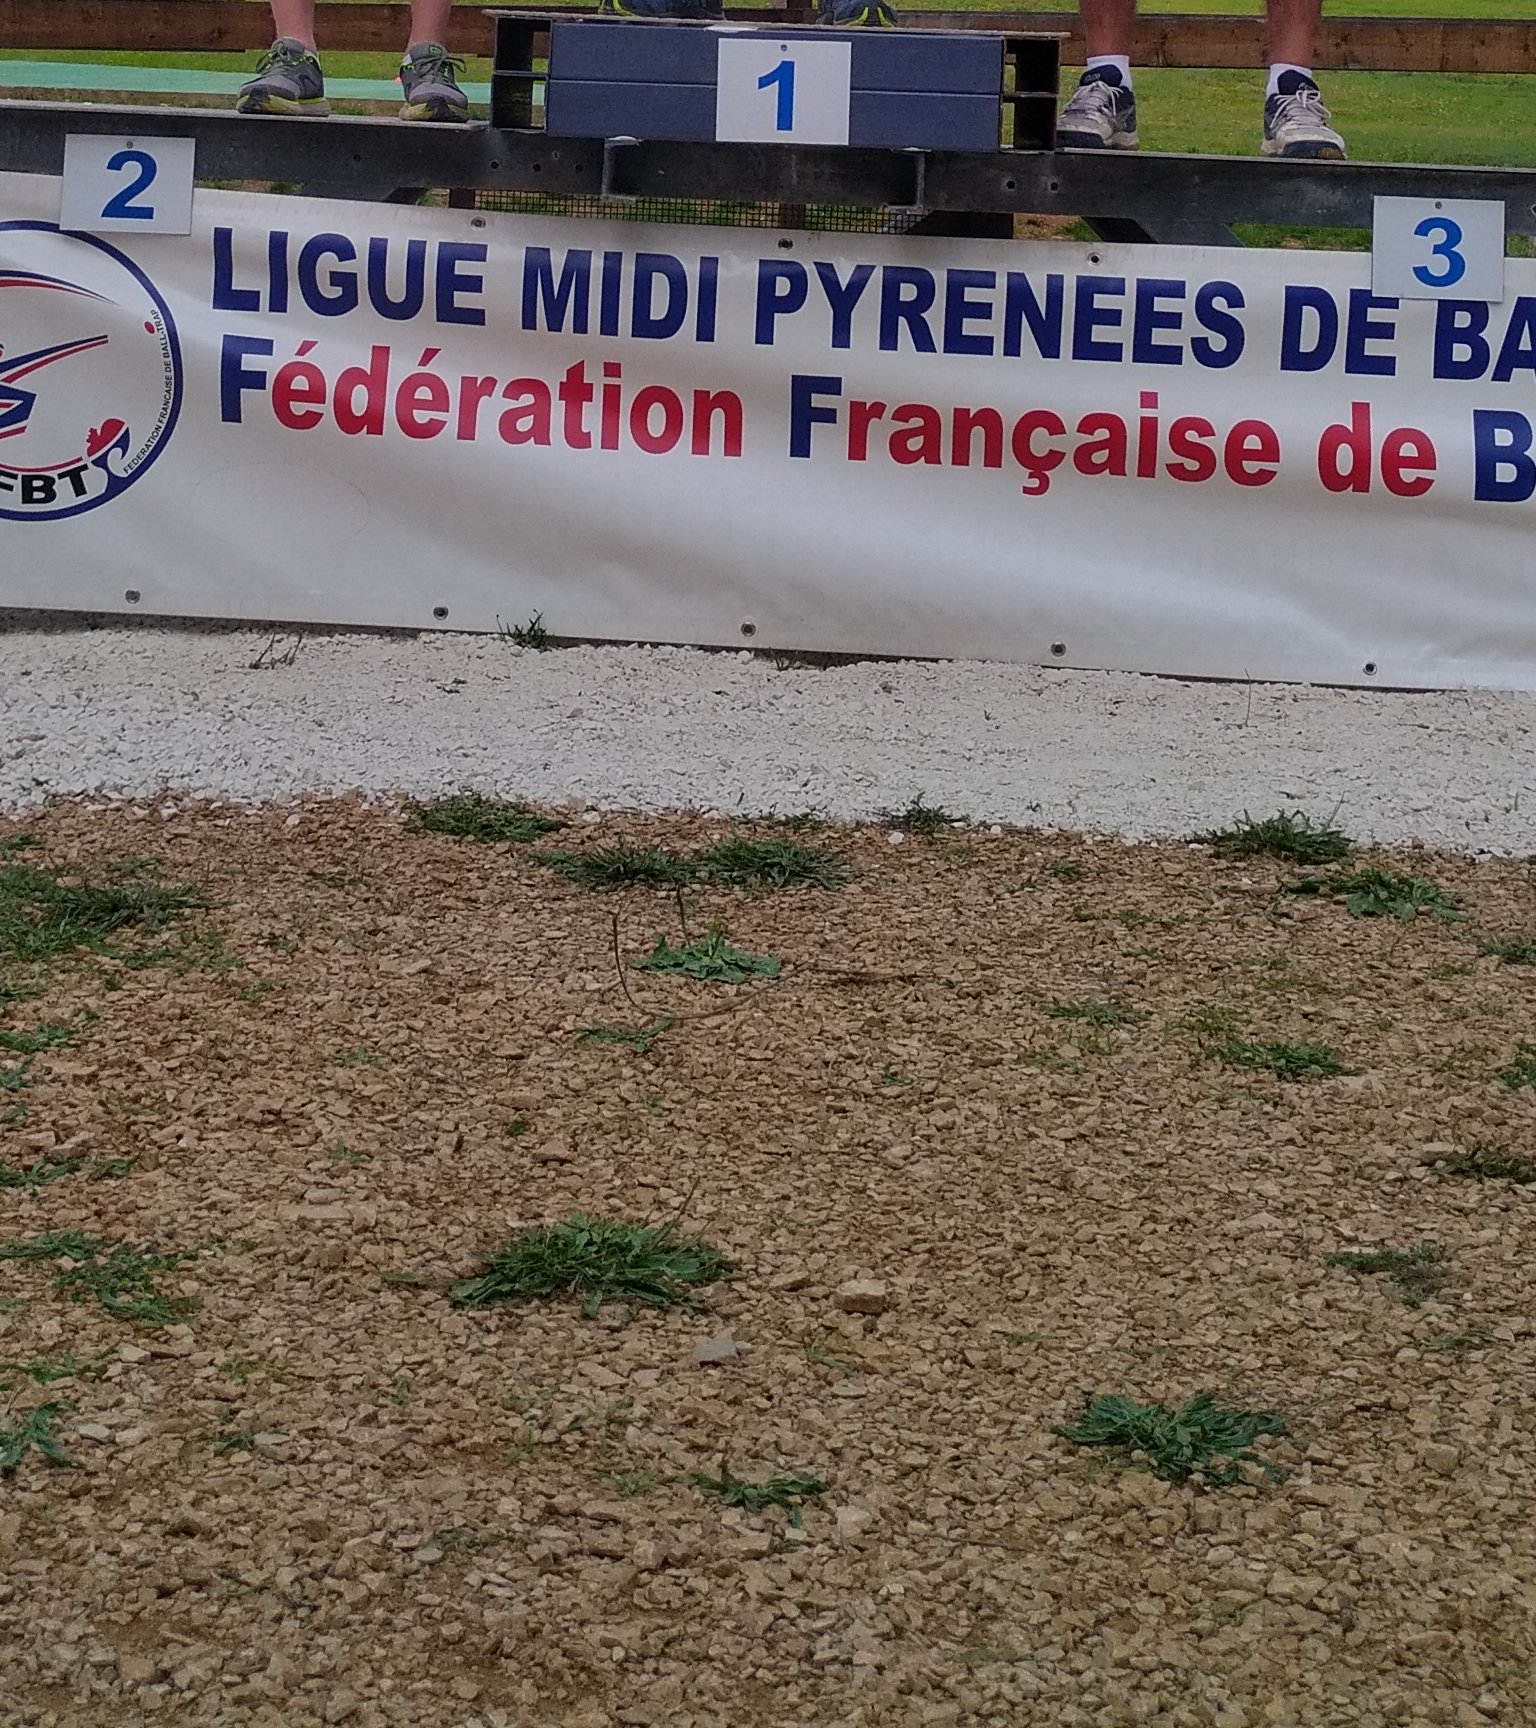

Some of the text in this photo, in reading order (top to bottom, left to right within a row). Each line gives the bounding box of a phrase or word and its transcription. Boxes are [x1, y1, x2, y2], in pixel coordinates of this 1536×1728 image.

[758, 60, 796, 131] 1
[102, 150, 156, 220] 2
[212, 226, 489, 326] LIGUE
[521, 246, 719, 343] MIDI
[754, 258, 1246, 369] PYRENEES
[1279, 285, 1400, 377] DE
[1412, 217, 1466, 288] 3
[122, 309, 173, 474] FEDERATION FRANCAISE DE BALL-TRAP
[220, 334, 742, 456] Fédération
[789, 374, 1280, 496] Française
[1318, 402, 1436, 496] de
